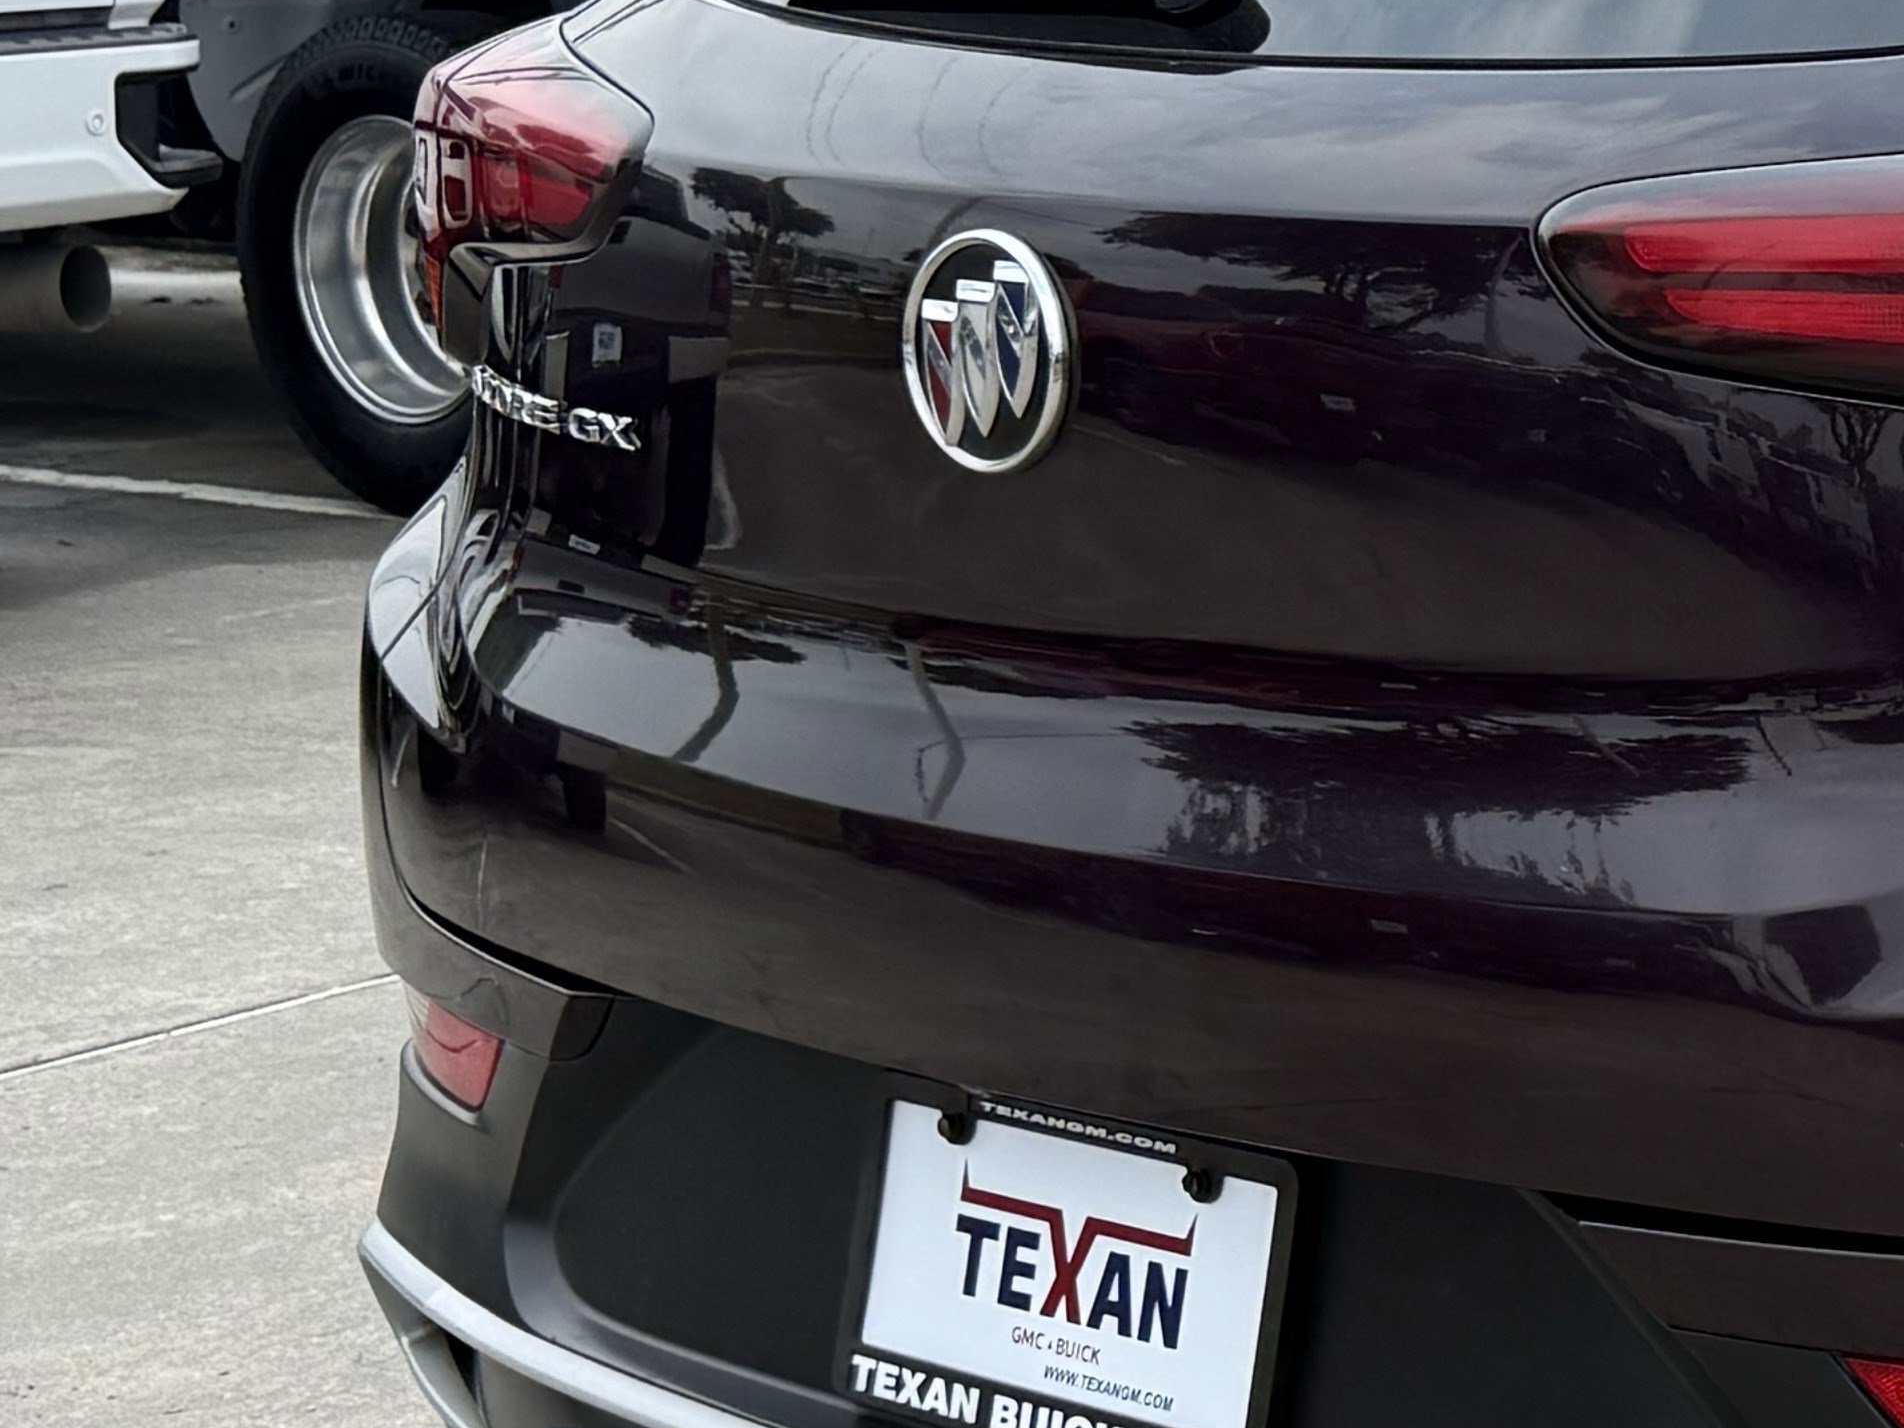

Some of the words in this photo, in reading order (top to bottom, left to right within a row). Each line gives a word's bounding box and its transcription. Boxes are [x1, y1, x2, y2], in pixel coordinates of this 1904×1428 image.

[567, 406, 642, 452] GX
[979, 1101, 1177, 1155] TEXANGM.COM
[955, 1178, 1194, 1350] TEXAN
[1012, 1325, 1045, 1351] GMC
[1055, 1337, 1101, 1366] BUICK
[850, 1353, 981, 1425] TEXAN
[1043, 1364, 1175, 1412] WWW.TEXANGM.COM
